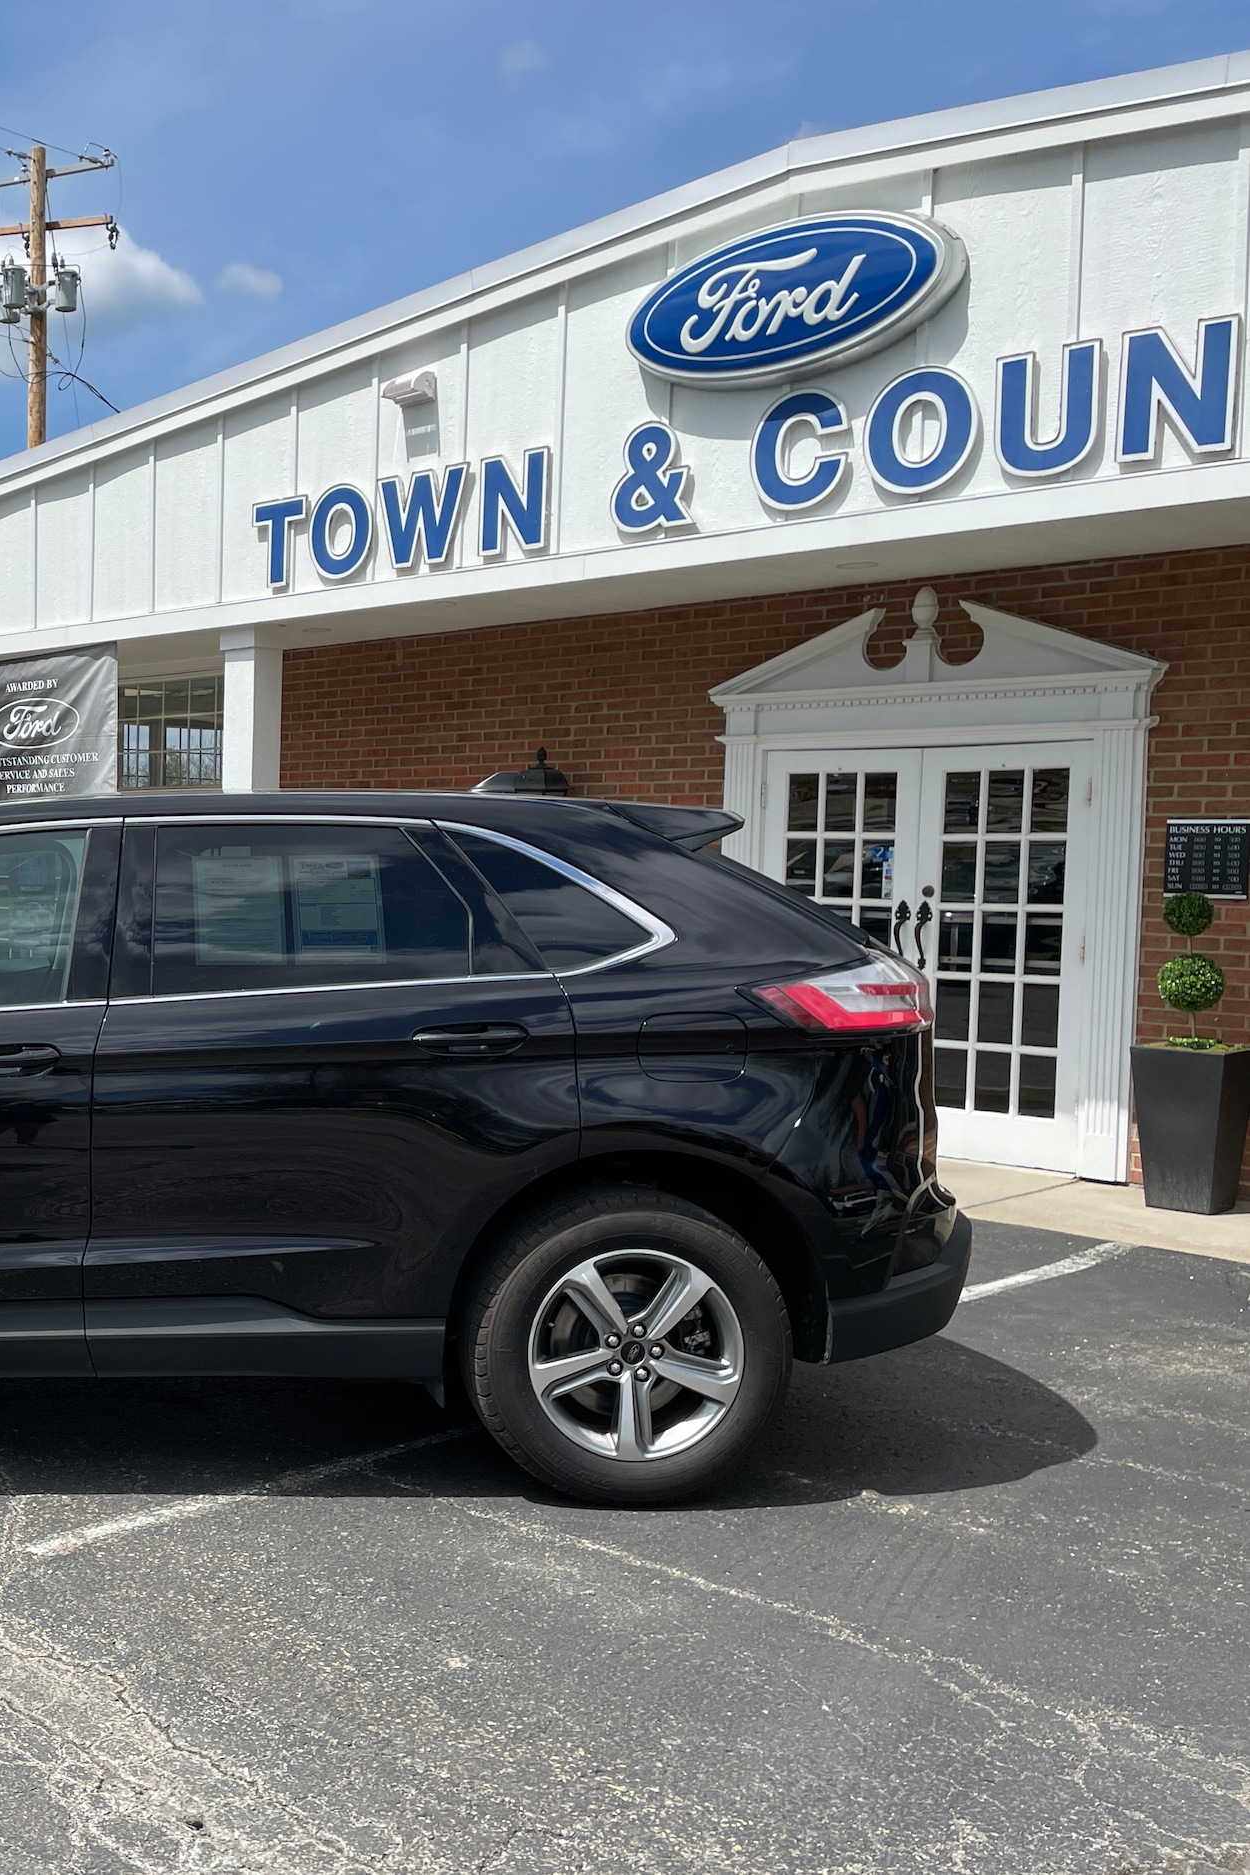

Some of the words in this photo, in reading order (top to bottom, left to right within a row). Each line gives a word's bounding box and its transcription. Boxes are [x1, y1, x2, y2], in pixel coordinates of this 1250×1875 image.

[680, 248, 867, 354] Ford
[252, 446, 551, 588] TOWN
[610, 420, 696, 533] &
[750, 313, 1241, 511] COUN
[5, 680, 44, 693] AWARDED
[47, 679, 58, 689] BY
[3, 705, 62, 740] Ford
[51, 752, 99, 764] CUSTOMER
[32, 769, 47, 779] AND
[49, 768, 75, 778] SALES
[6, 783, 65, 794] PERFORMANCE
[1169, 826, 1210, 834] BUSINESS
[1213, 826, 1247, 834] HOURS
